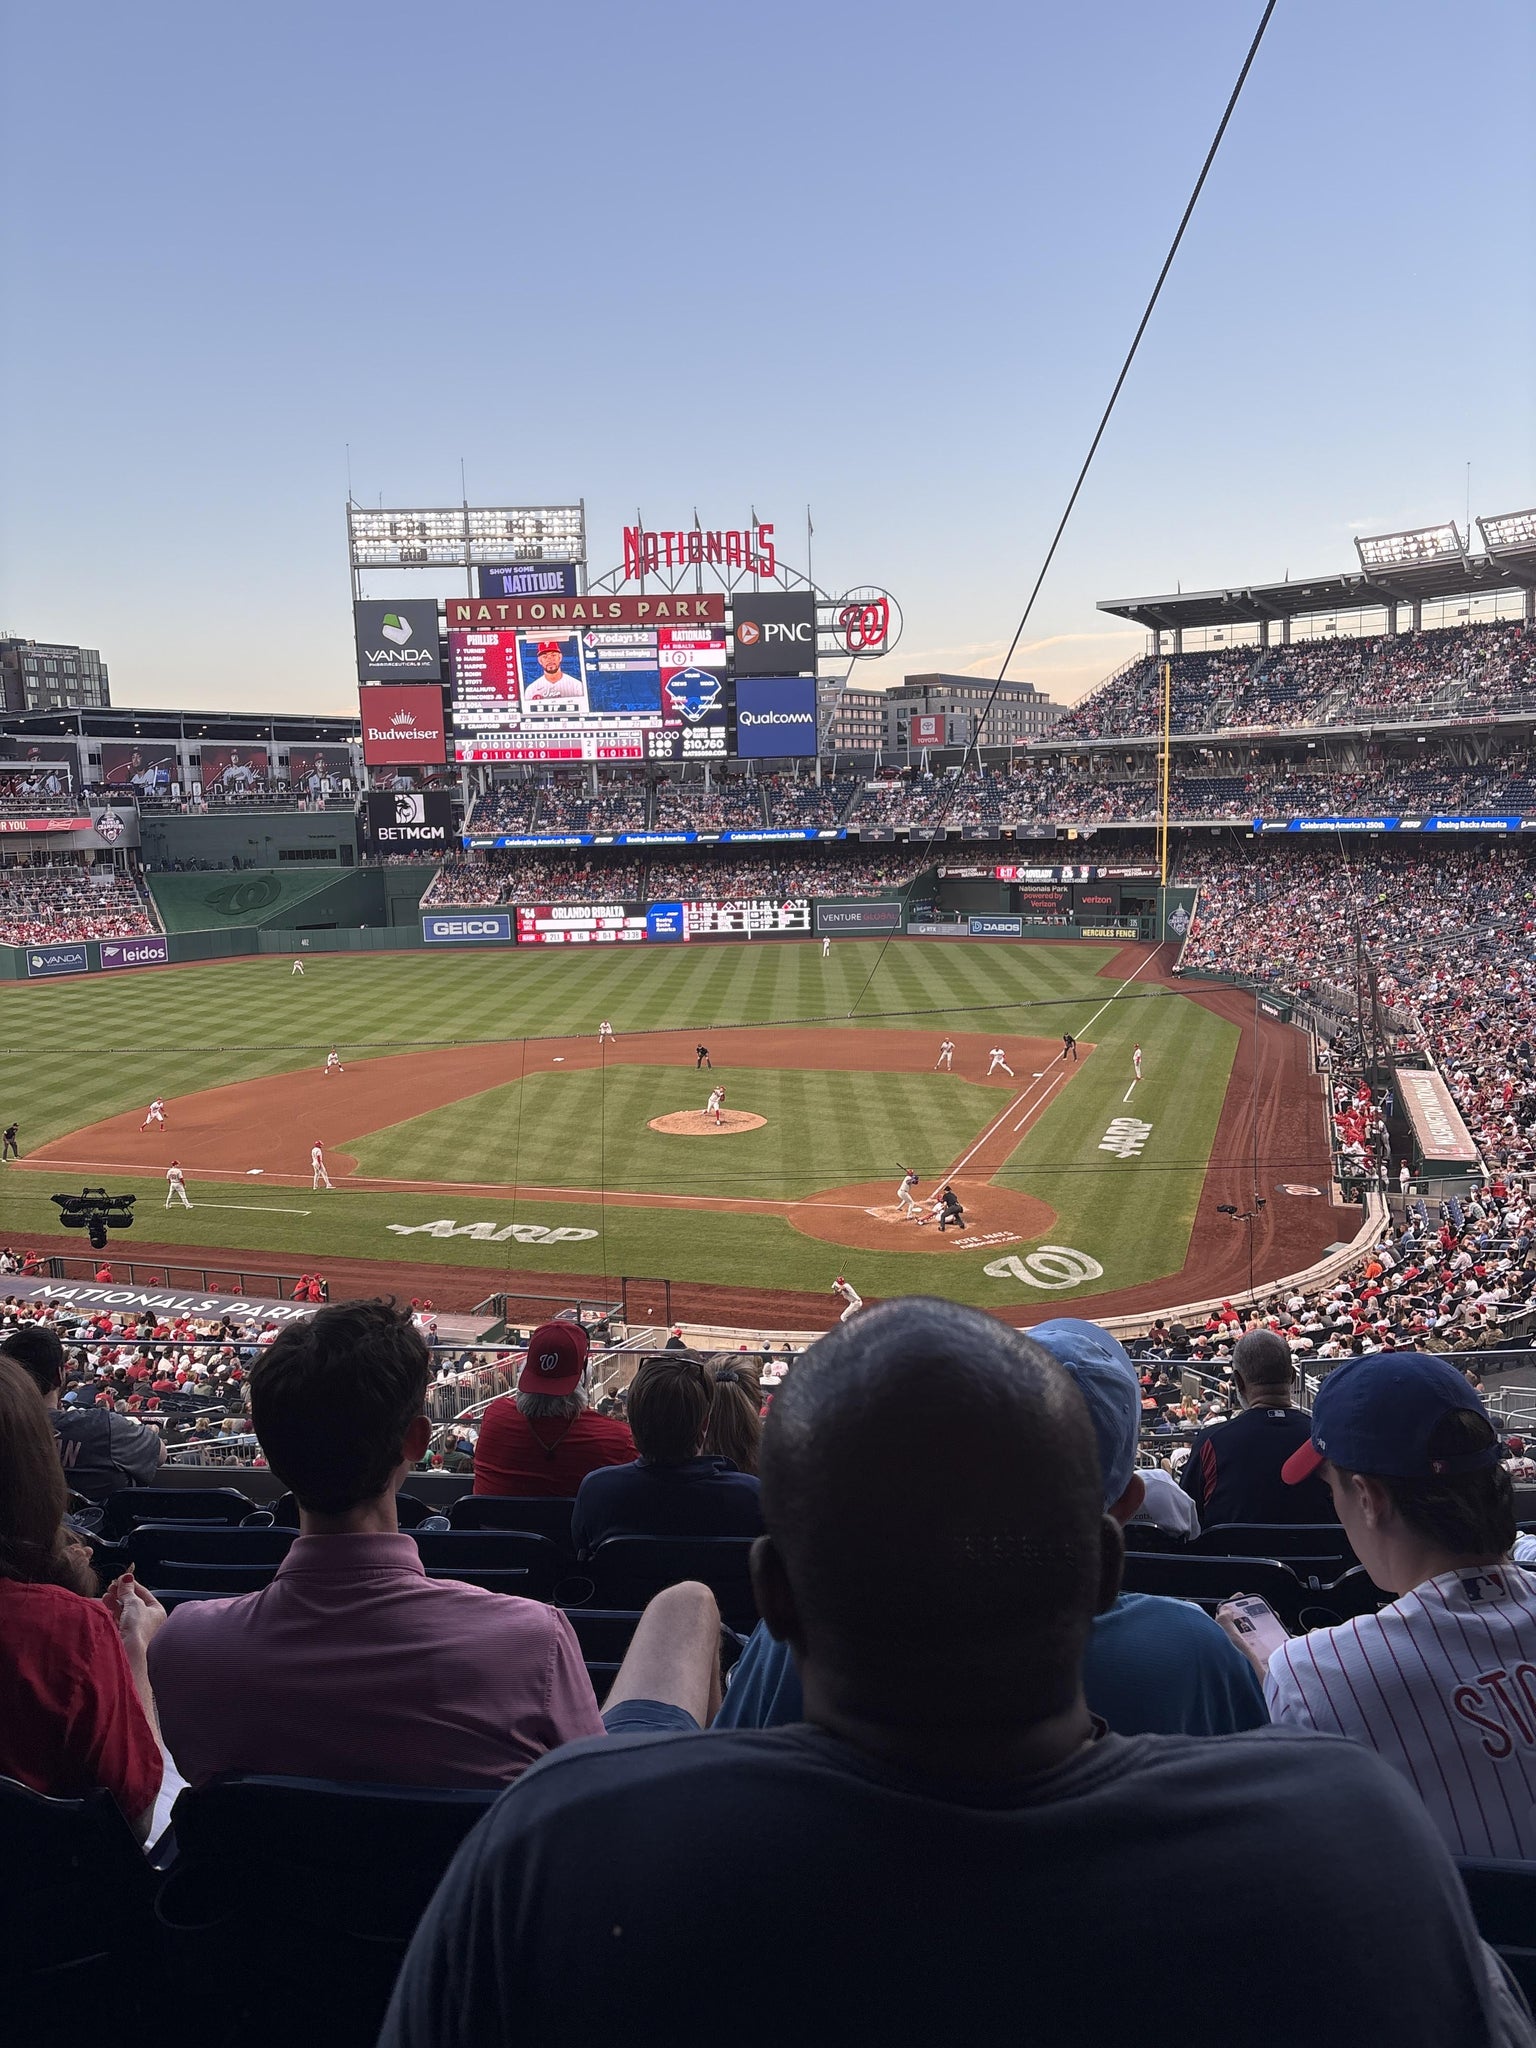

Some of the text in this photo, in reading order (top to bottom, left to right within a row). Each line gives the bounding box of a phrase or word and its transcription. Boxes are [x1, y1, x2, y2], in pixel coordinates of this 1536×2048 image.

[623, 524, 774, 579] NATIONALS
[489, 566, 534, 575] SHOW SOME
[503, 572, 564, 593] NATITUDE
[457, 600, 710, 621] NATIONALS PARK
[672, 630, 712, 641] NATIONALS
[762, 623, 812, 641] PNC
[466, 634, 499, 646] PHILLIES
[365, 650, 433, 662] VANDA
[740, 710, 813, 726] Qualcomm
[368, 728, 439, 740] Budweiser
[683, 740, 724, 750] $10,760
[9, 821, 29, 830] YOU.
[378, 826, 444, 840] BETMGM
[1000, 868, 1012, 877] 8:17
[1024, 892, 1064, 900] powered by
[1082, 896, 1112, 904] verizon
[1030, 900, 1056, 908] Verizon
[552, 907, 590, 919] ORLANDO
[592, 906, 625, 918] RIBALTA
[822, 912, 896, 922] VENTURE GLOBAL
[433, 921, 499, 936] GEICO
[983, 923, 1020, 932] DABOS
[1082, 929, 1136, 938] HERCULES FENCE
[43, 954, 83, 965] VANDA
[122, 946, 165, 962] leidos
[386, 1220, 600, 1244] AARP
[29, 1285, 319, 1321] NATIONALS PARK
